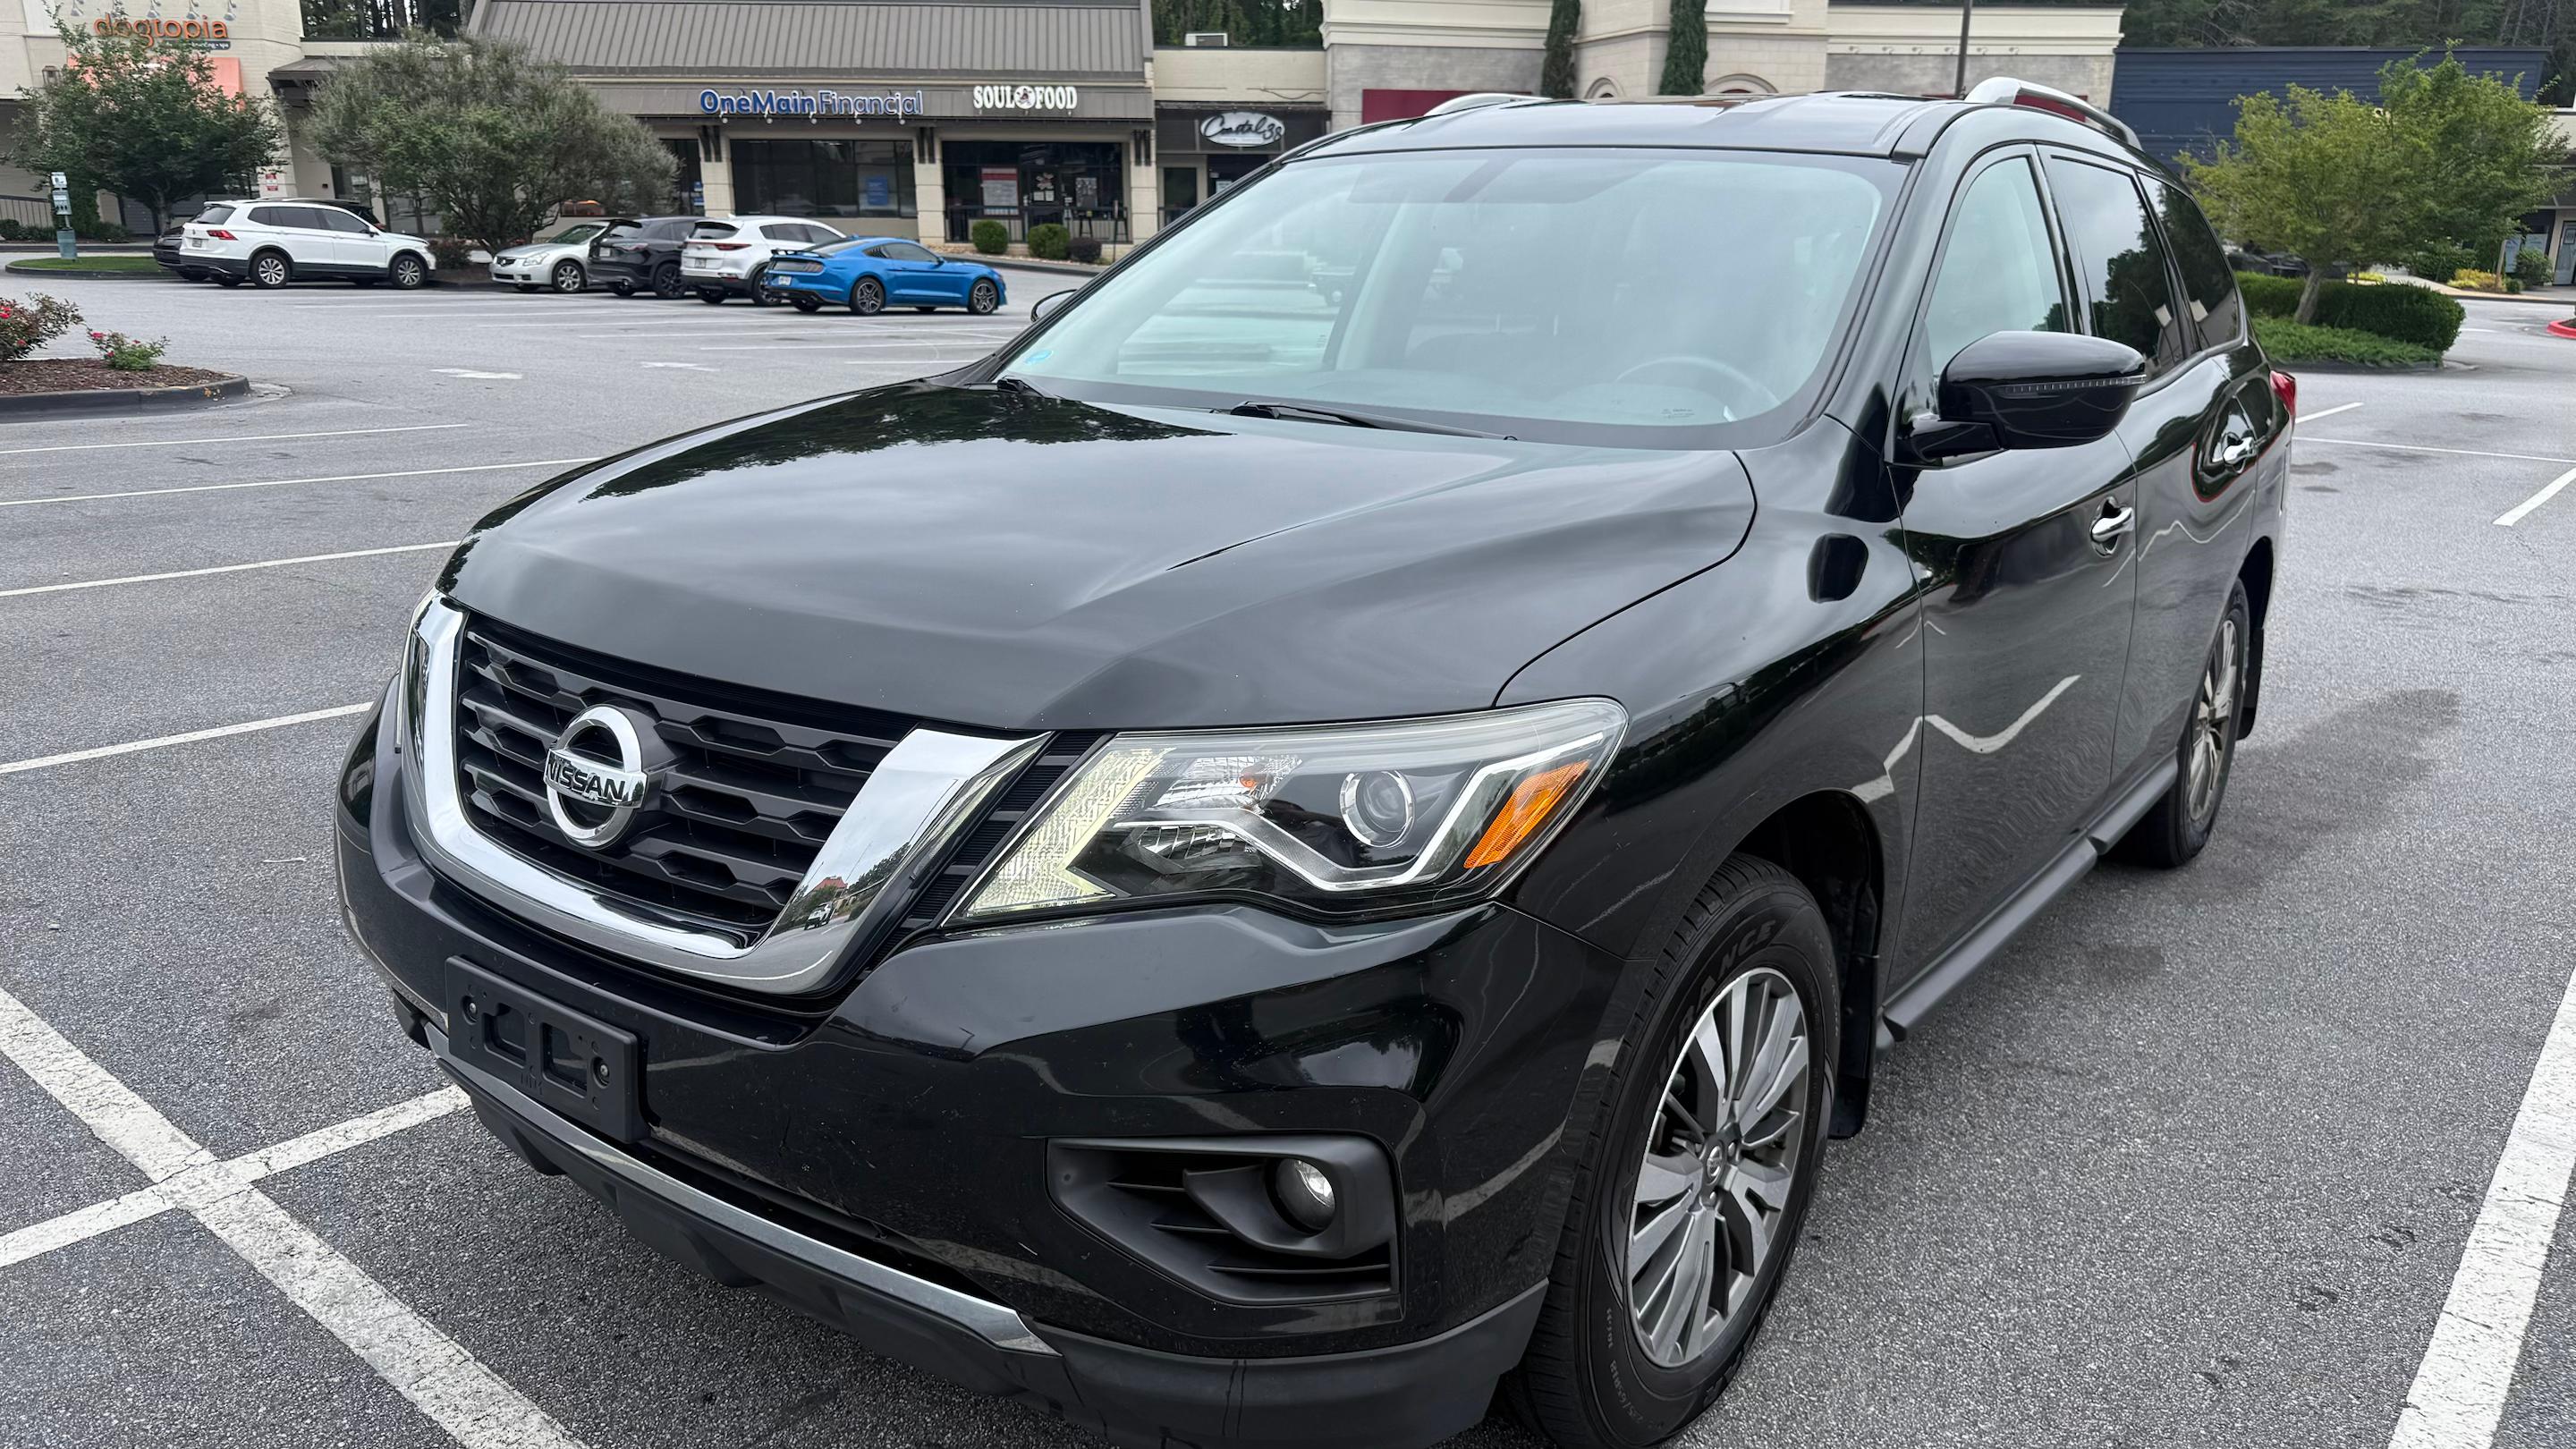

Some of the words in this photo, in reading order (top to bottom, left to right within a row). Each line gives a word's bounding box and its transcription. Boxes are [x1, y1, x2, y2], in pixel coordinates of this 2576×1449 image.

[94, 12, 229, 48] dogtopia
[699, 89, 817, 114] OneMain
[818, 89, 924, 115] Financial
[973, 85, 1015, 108] SOUL
[1034, 86, 1077, 109] FOOD
[547, 758, 625, 802] NISSAN
